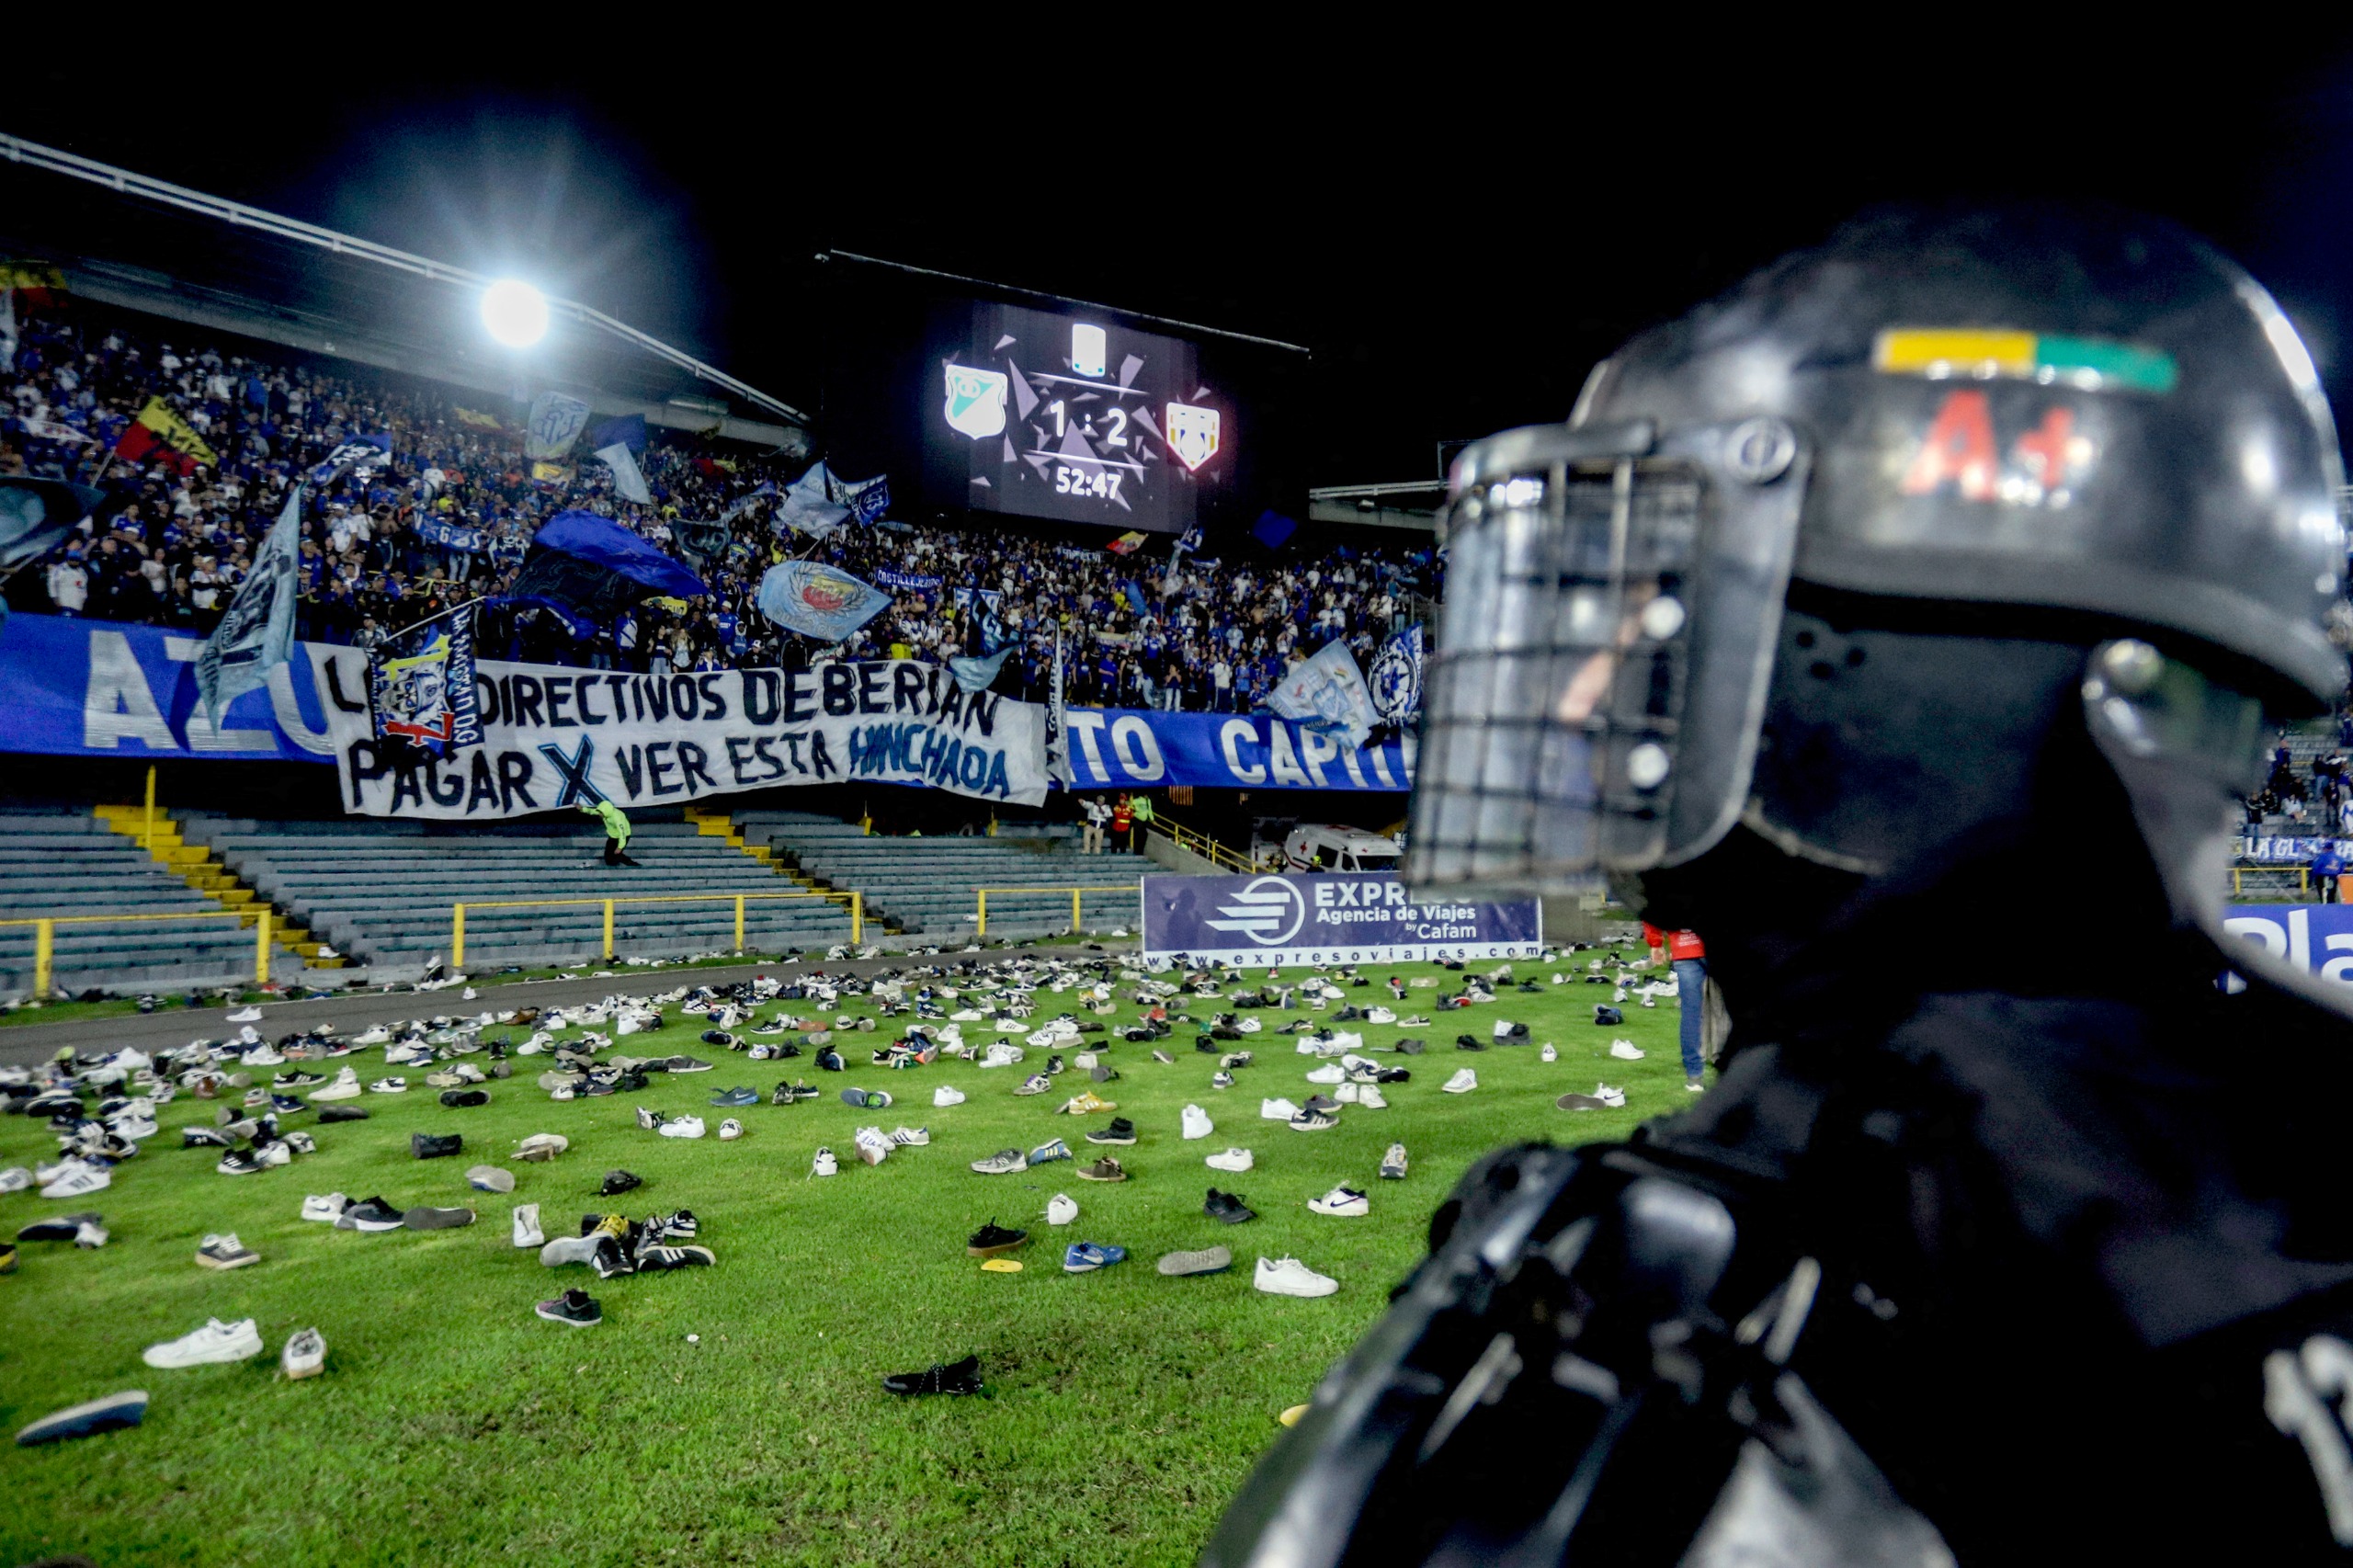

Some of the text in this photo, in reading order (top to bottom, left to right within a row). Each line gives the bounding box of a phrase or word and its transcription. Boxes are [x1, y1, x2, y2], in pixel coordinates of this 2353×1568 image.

[1050, 400, 1064, 437] 1
[1107, 408, 1128, 447] 2
[1055, 466, 1121, 499] 52:47
[476, 674, 727, 728] DIRECTIVOS
[741, 662, 1001, 736] DEBERIAN
[1066, 710, 1165, 783] TO
[348, 722, 1010, 815] PAGAR X VER ESTA HINCHADA
[1315, 881, 1472, 907] EXPR
[1316, 904, 1476, 925] Agencia de Viajes
[1404, 923, 1477, 939] by Cafam
[1147, 946, 1540, 966] wwexpresoviajes.com
